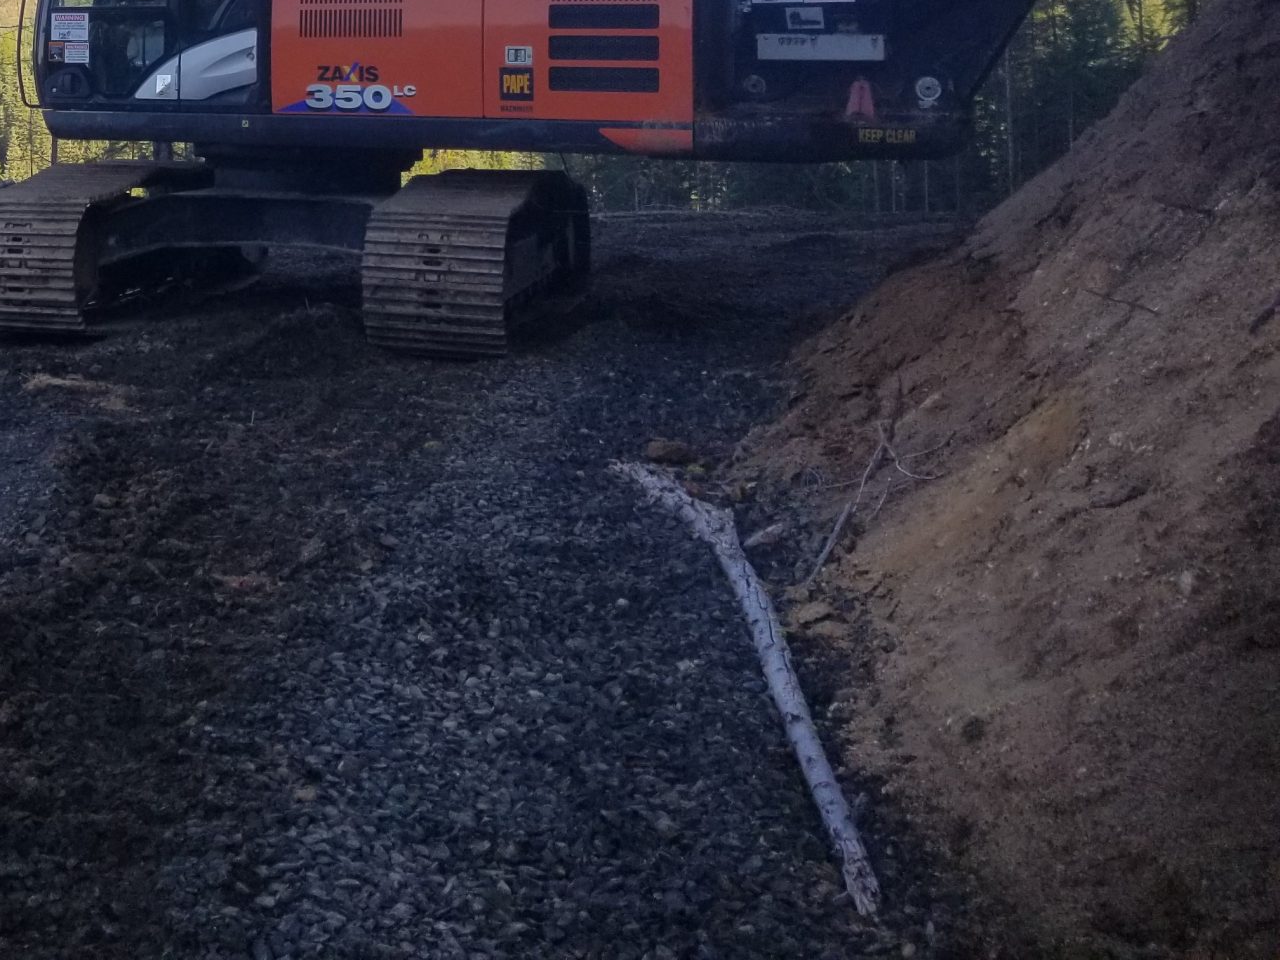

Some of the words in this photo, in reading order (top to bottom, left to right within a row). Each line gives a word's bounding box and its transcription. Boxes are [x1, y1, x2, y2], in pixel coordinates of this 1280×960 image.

[317, 62, 380, 83] ZAXIS
[305, 84, 392, 111] 350
[858, 128, 884, 143] KEEP
[885, 128, 917, 144] CLEAR
